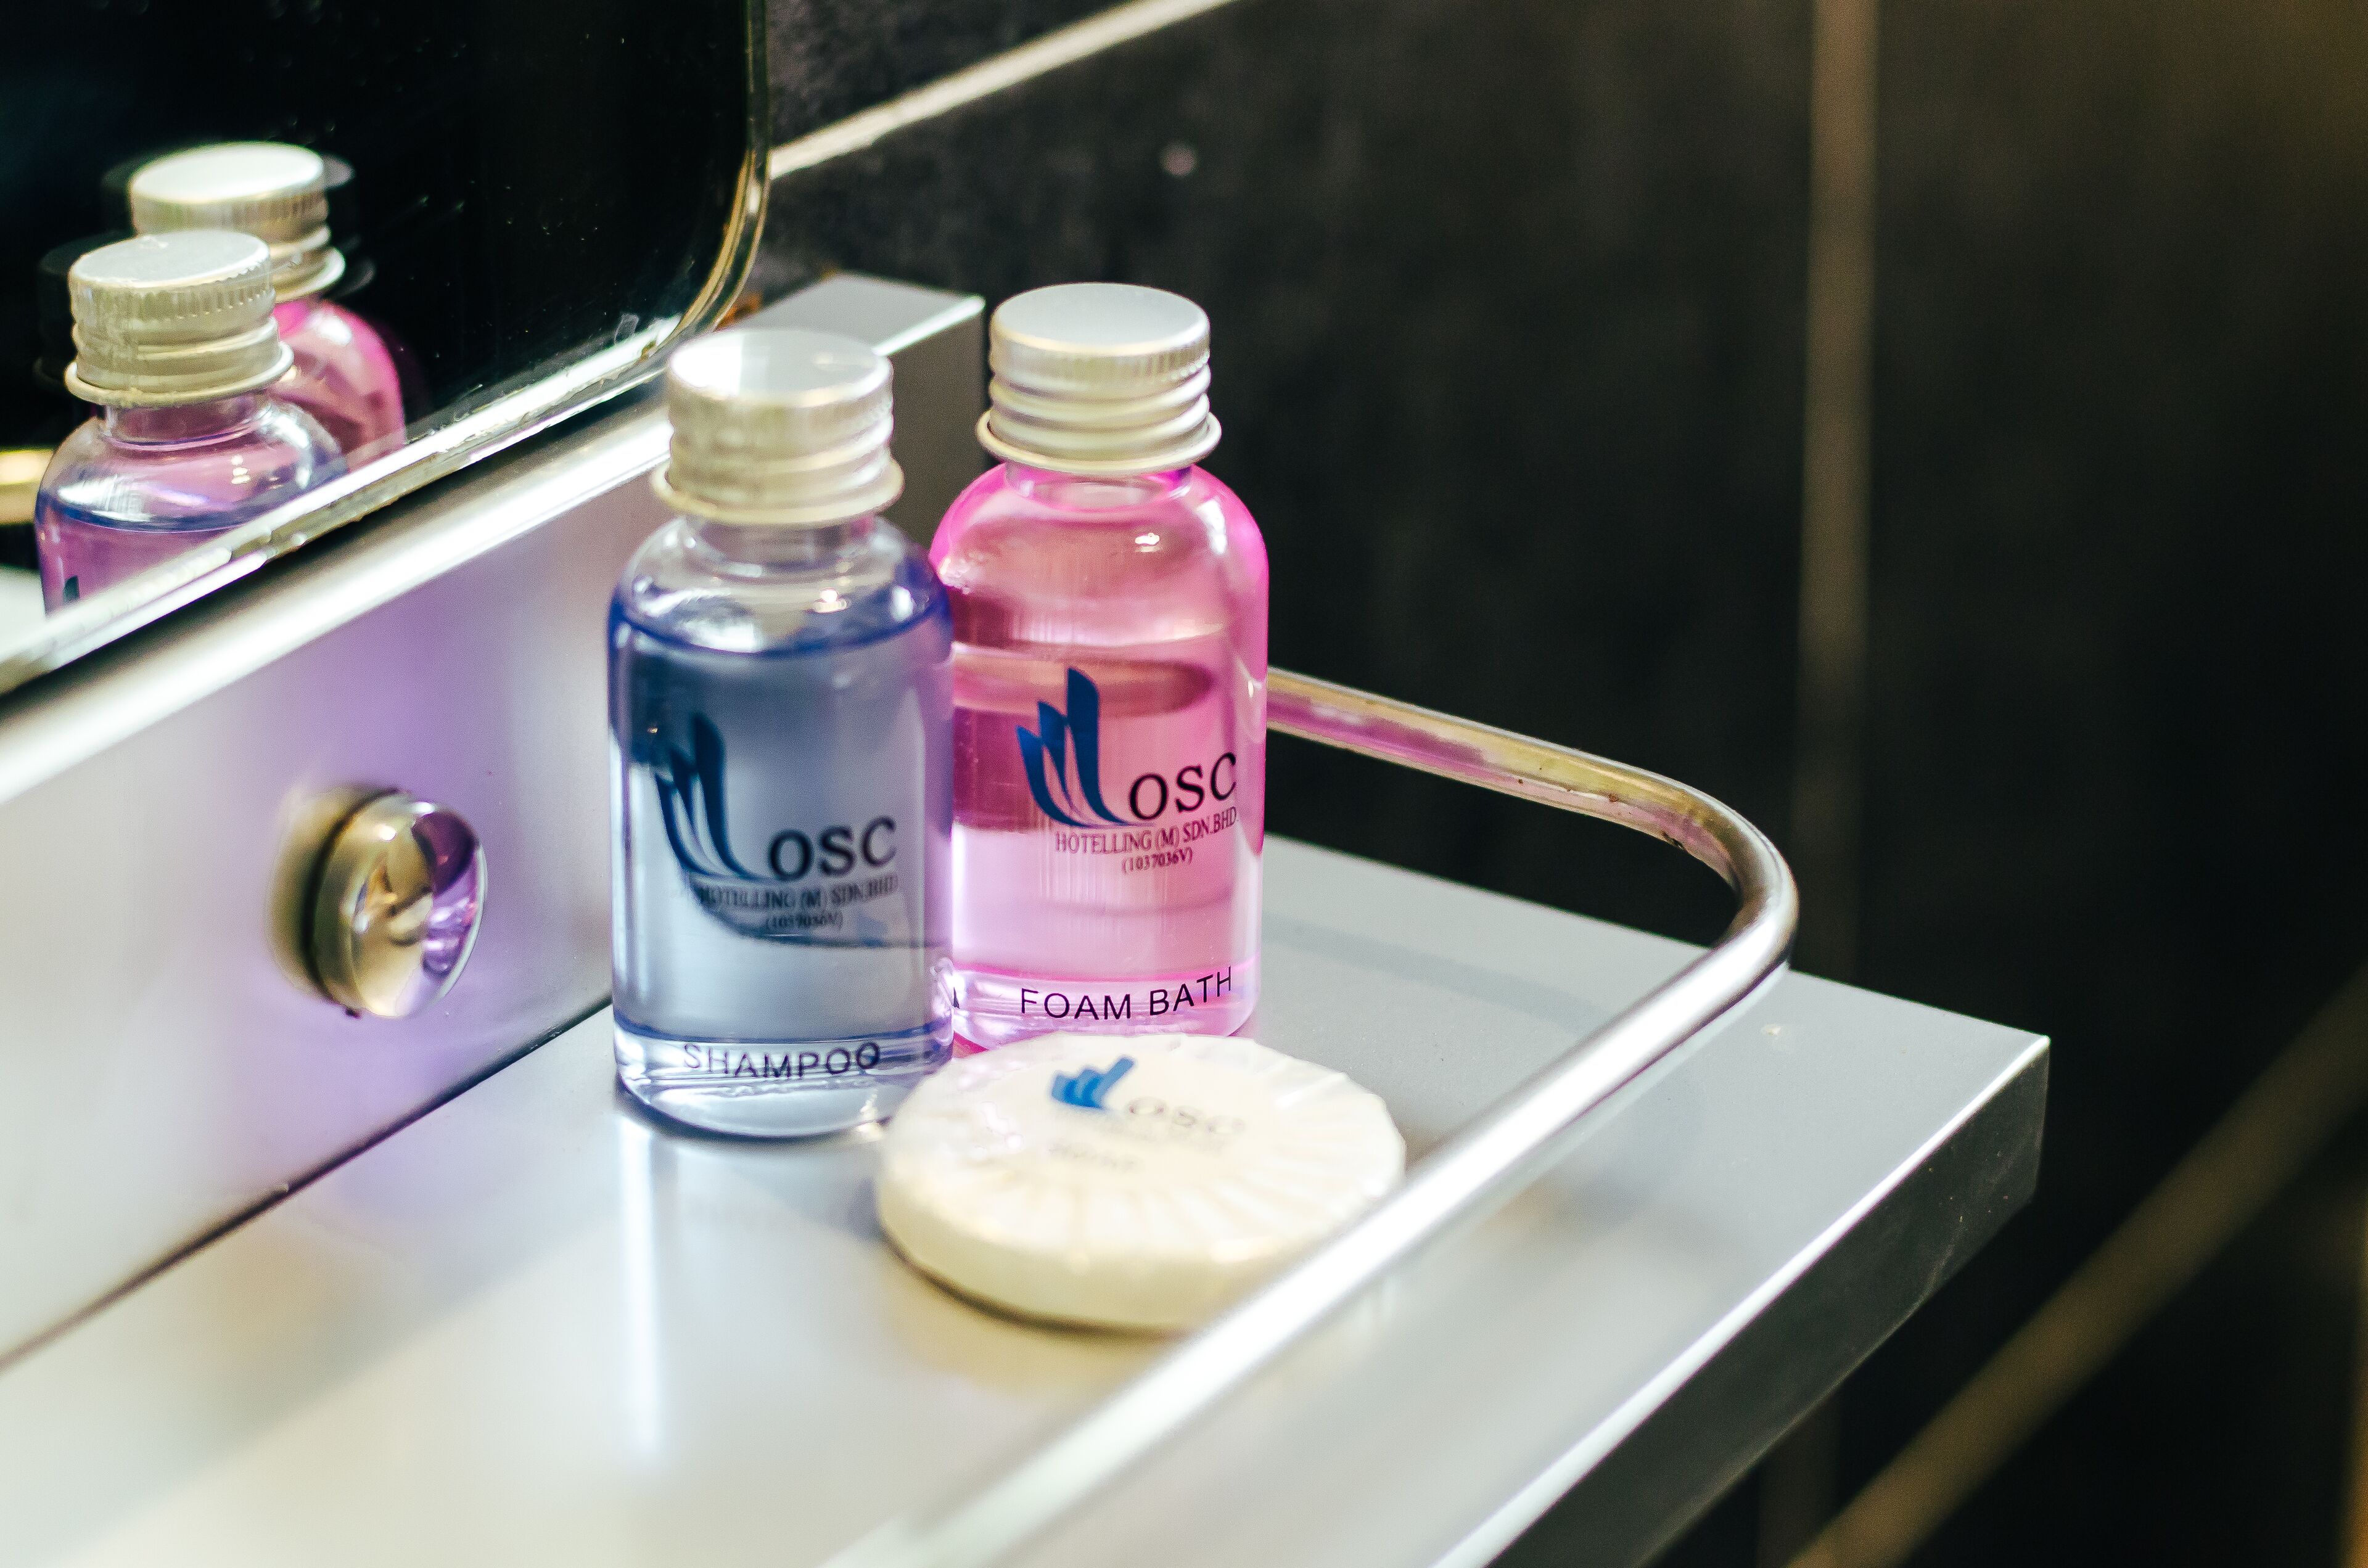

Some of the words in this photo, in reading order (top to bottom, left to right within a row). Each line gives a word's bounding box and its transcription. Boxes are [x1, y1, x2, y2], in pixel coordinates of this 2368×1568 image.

[1128, 751, 1236, 821] OSC
[768, 816, 897, 882] OSC
[1054, 830, 1152, 855] HOTELLING
[1154, 826, 1180, 851] (M)
[1021, 987, 1132, 1020] FOAM
[1149, 965, 1231, 1016] BATH
[683, 1041, 881, 1079] SHAMPOO
[1126, 1096, 1246, 1136] OSC
